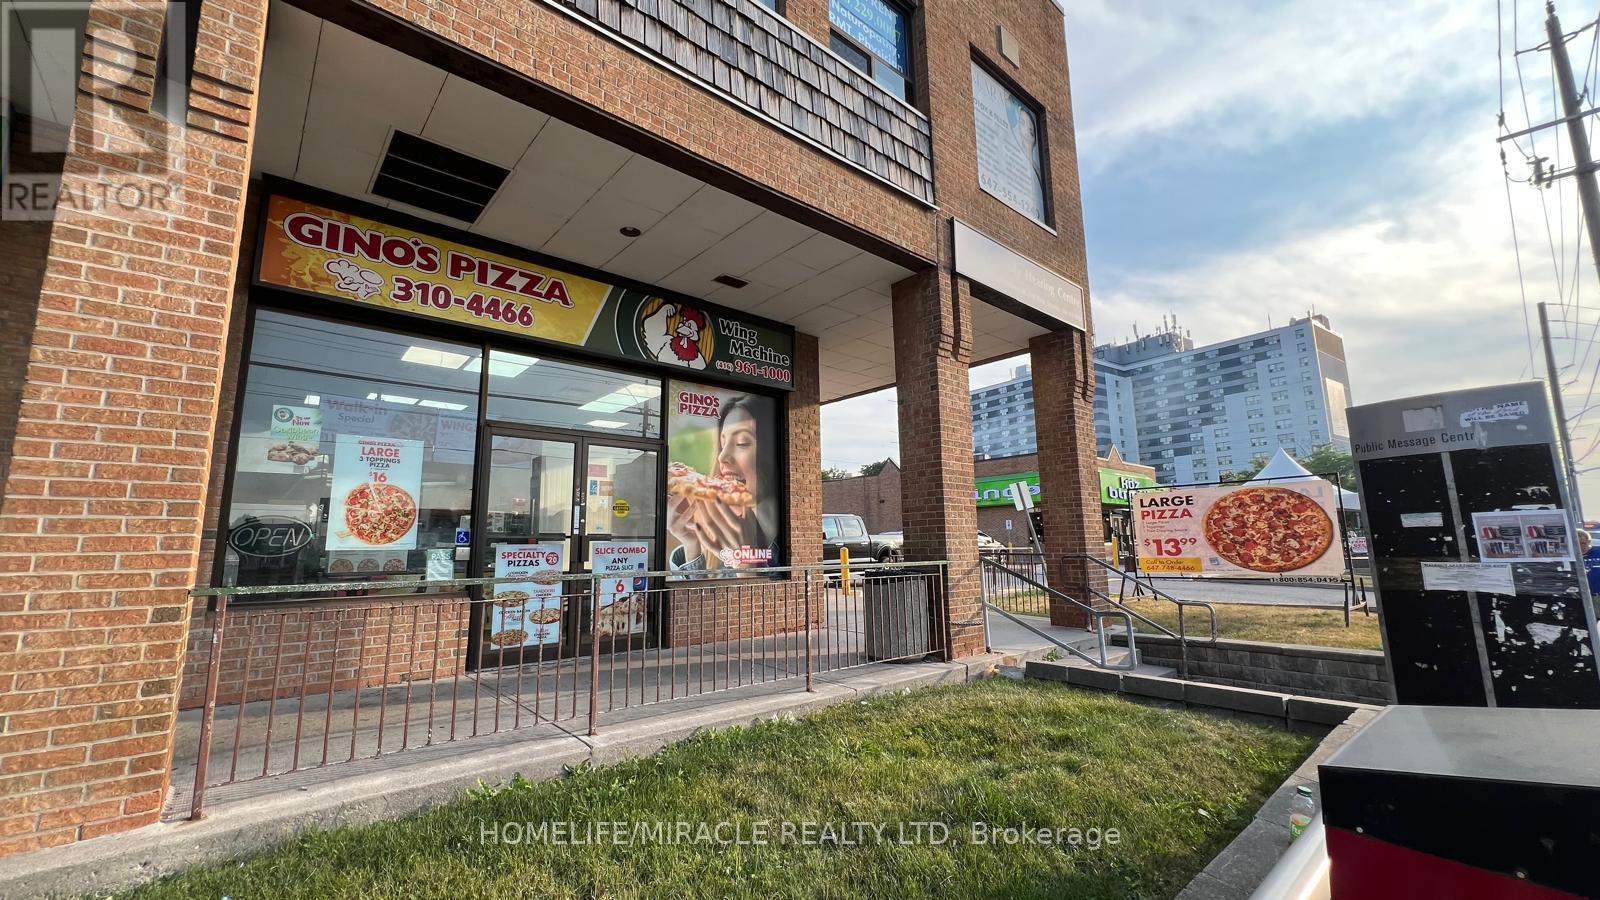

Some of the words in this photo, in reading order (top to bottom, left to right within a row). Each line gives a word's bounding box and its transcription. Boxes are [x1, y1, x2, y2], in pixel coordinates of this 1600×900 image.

[284, 213, 441, 272] GINO'S
[447, 251, 574, 308] PIZZA
[391, 276, 535, 328] 310-4466
[719, 318, 757, 345] Wing
[729, 339, 790, 366] Machine
[735, 360, 791, 382] 961-1000
[680, 391, 719, 407] GINO'S
[338, 412, 375, 423] Special
[679, 404, 720, 419] PIZZA
[1355, 442, 1384, 453] Public
[1388, 436, 1436, 449] Message
[1441, 432, 1475, 443] Centr
[361, 447, 400, 458] LARGE
[366, 456, 400, 464] TOPPINGS
[369, 471, 387, 483] $16
[1140, 496, 1194, 508] LARGE
[1141, 508, 1193, 520] PIZZA
[235, 527, 304, 547] OPEN
[431, 552, 451, 560] PASS
[501, 551, 546, 559] SPECIALTY
[617, 546, 646, 554] COMBO
[734, 548, 772, 559] ONLINE
